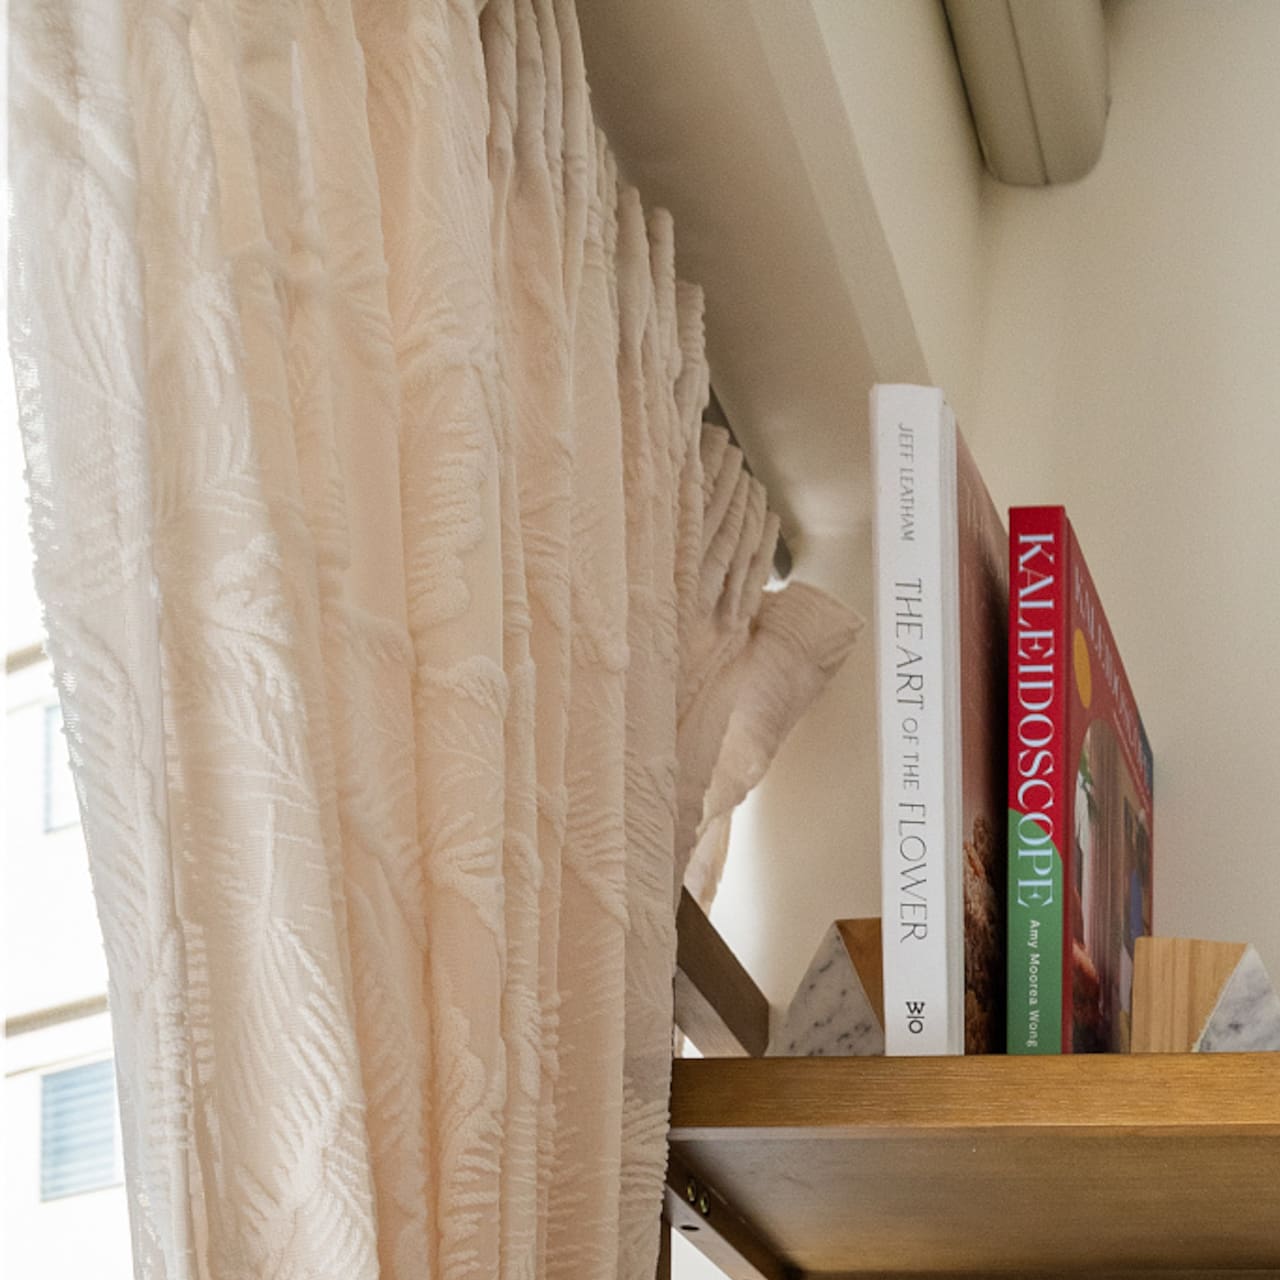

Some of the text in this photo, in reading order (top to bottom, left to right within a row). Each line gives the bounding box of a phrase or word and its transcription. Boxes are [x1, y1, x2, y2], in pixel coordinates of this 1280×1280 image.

[897, 423, 915, 541] JEFF LEATHAM
[895, 578, 928, 944] THE ART OF THE FLOWER
[1017, 533, 1054, 908] KALEIDOSCOPE
[1026, 919, 1041, 1048] Amy Moorea Wong
